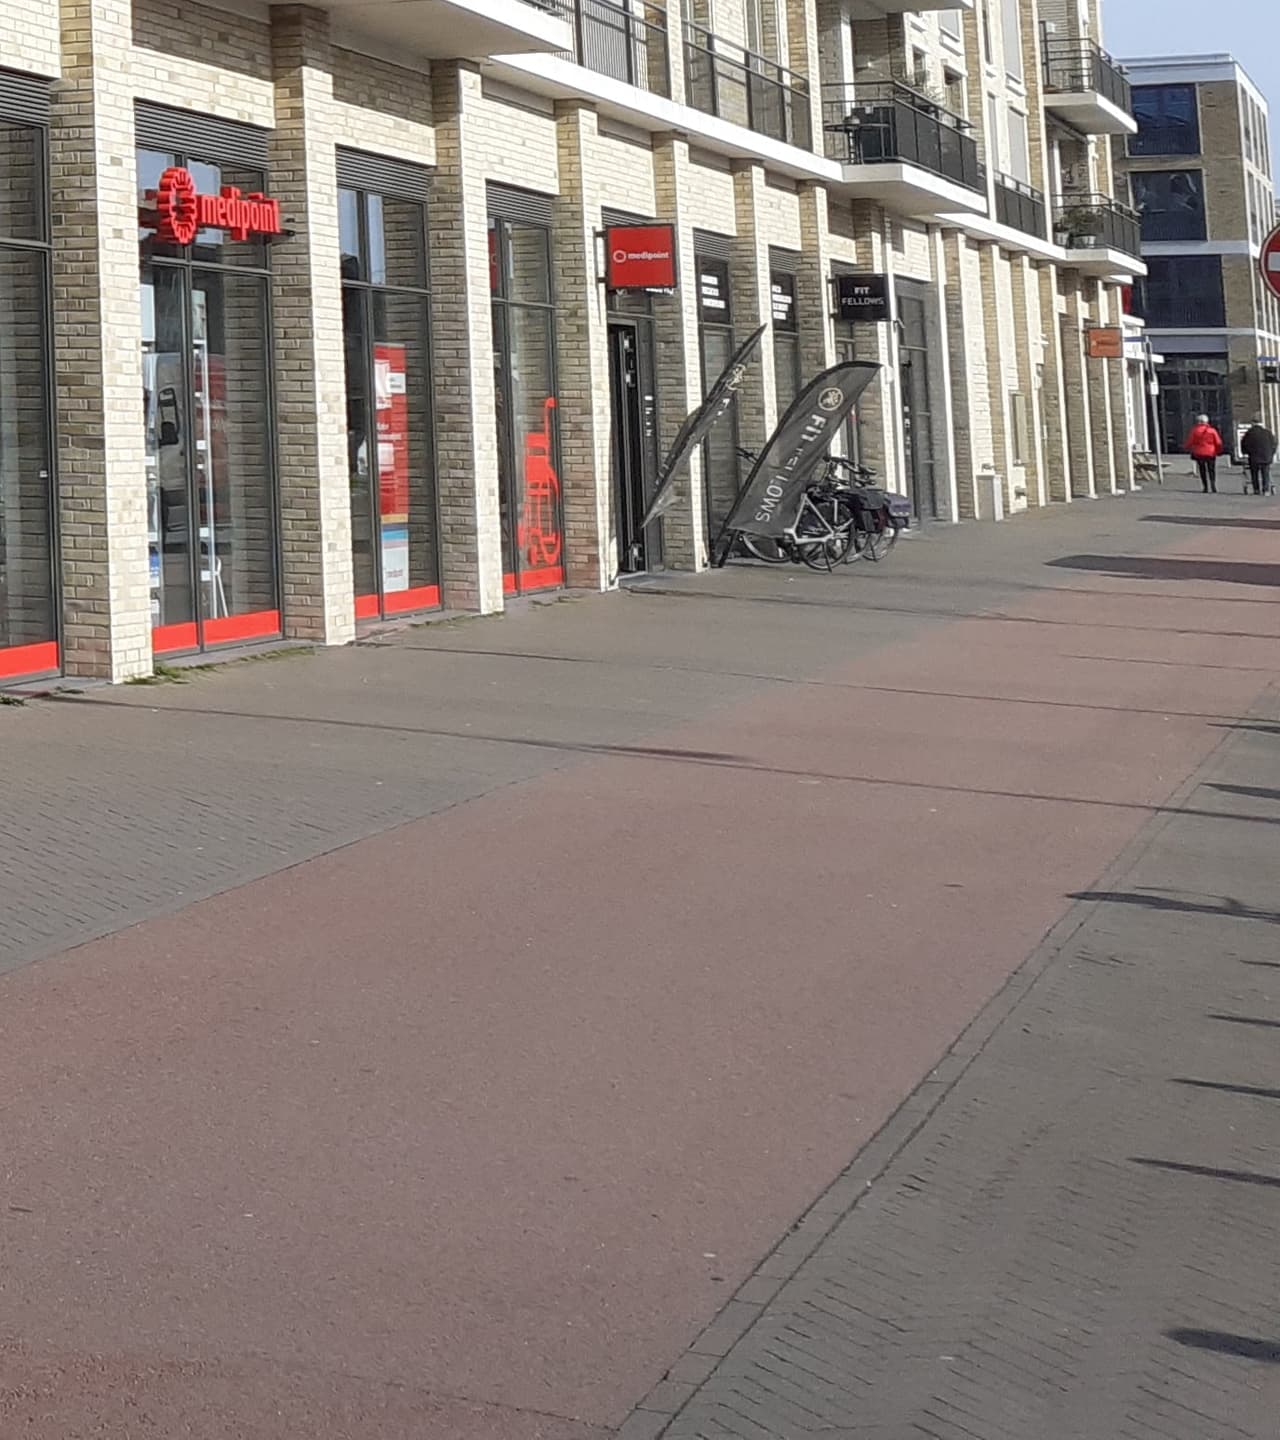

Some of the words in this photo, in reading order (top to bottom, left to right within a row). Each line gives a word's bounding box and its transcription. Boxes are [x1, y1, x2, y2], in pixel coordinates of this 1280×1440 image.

[198, 185, 281, 241] medipoint
[854, 286, 871, 295] FIT
[841, 297, 884, 306] FELLOWS
